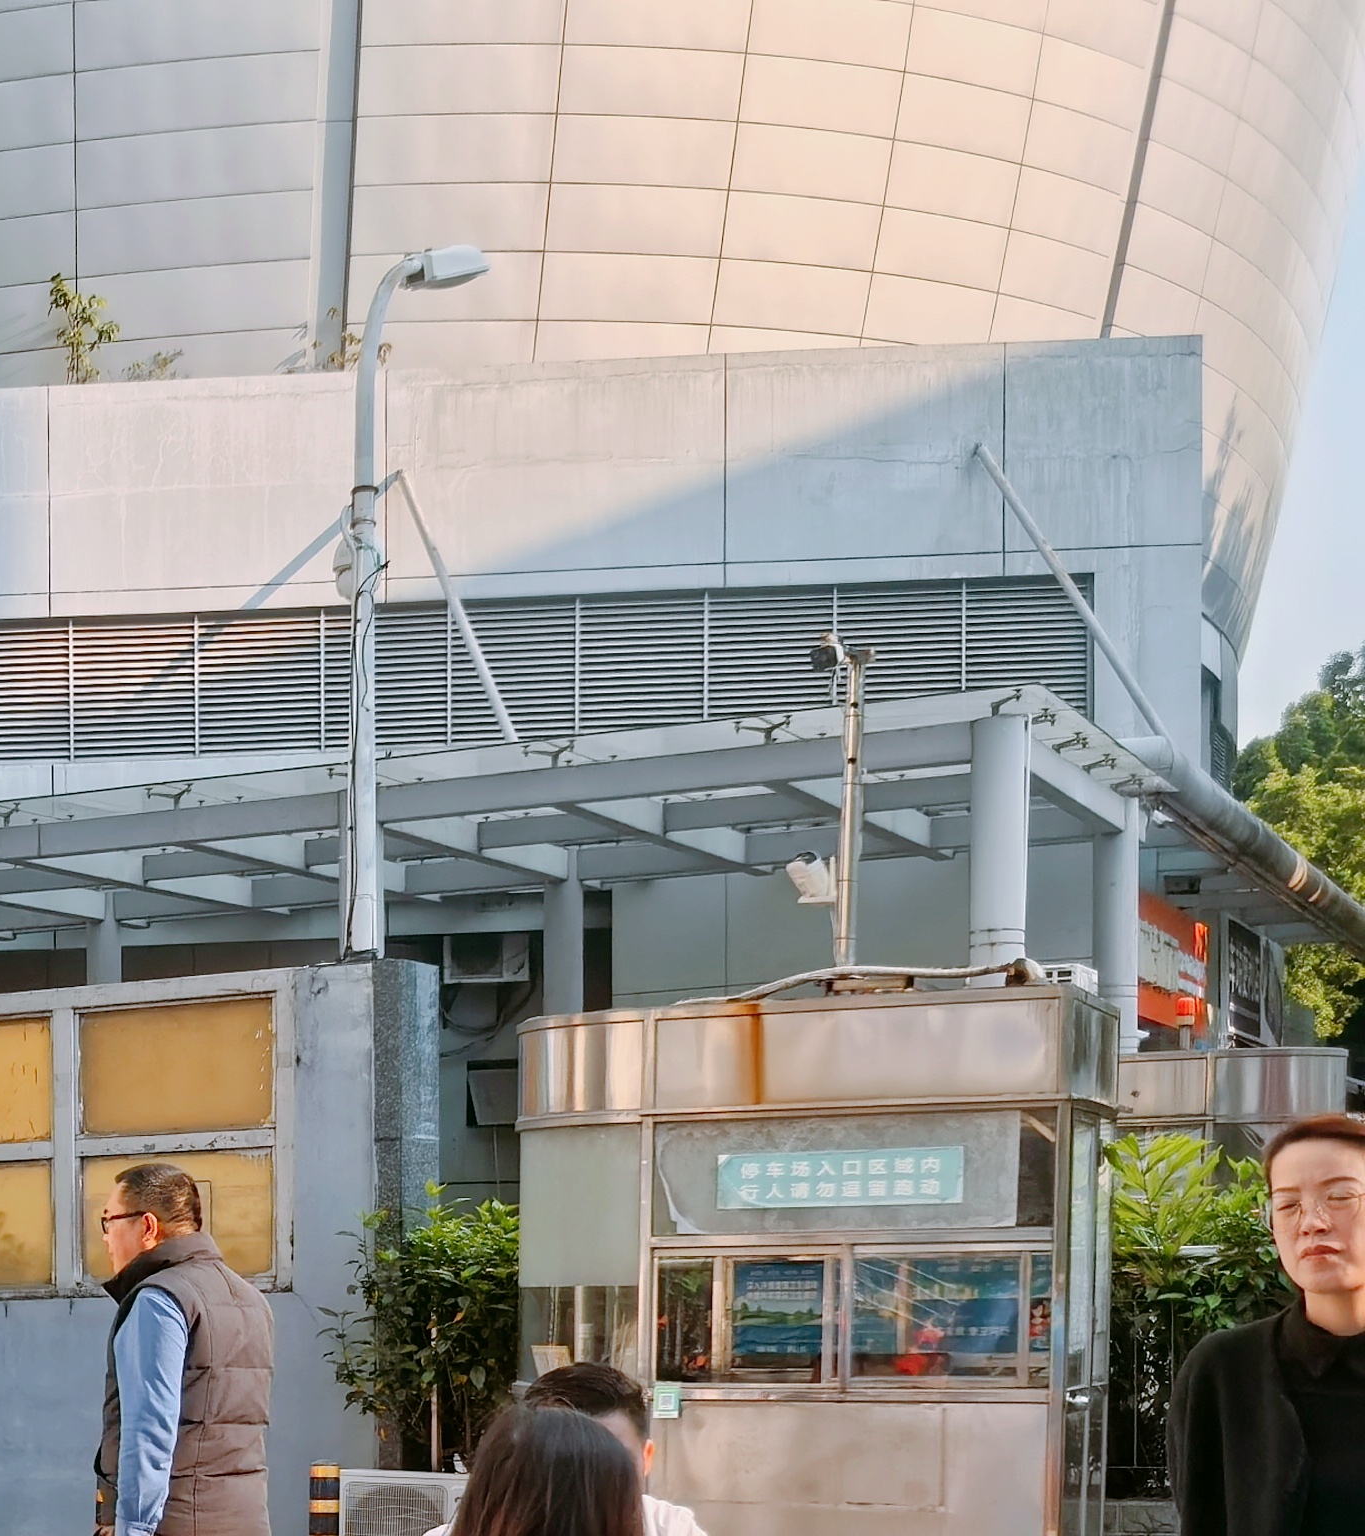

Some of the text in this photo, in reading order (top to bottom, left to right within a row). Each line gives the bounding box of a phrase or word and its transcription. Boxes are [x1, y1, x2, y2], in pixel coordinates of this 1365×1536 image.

[740, 1156, 941, 1179] 停车场入口区域内
